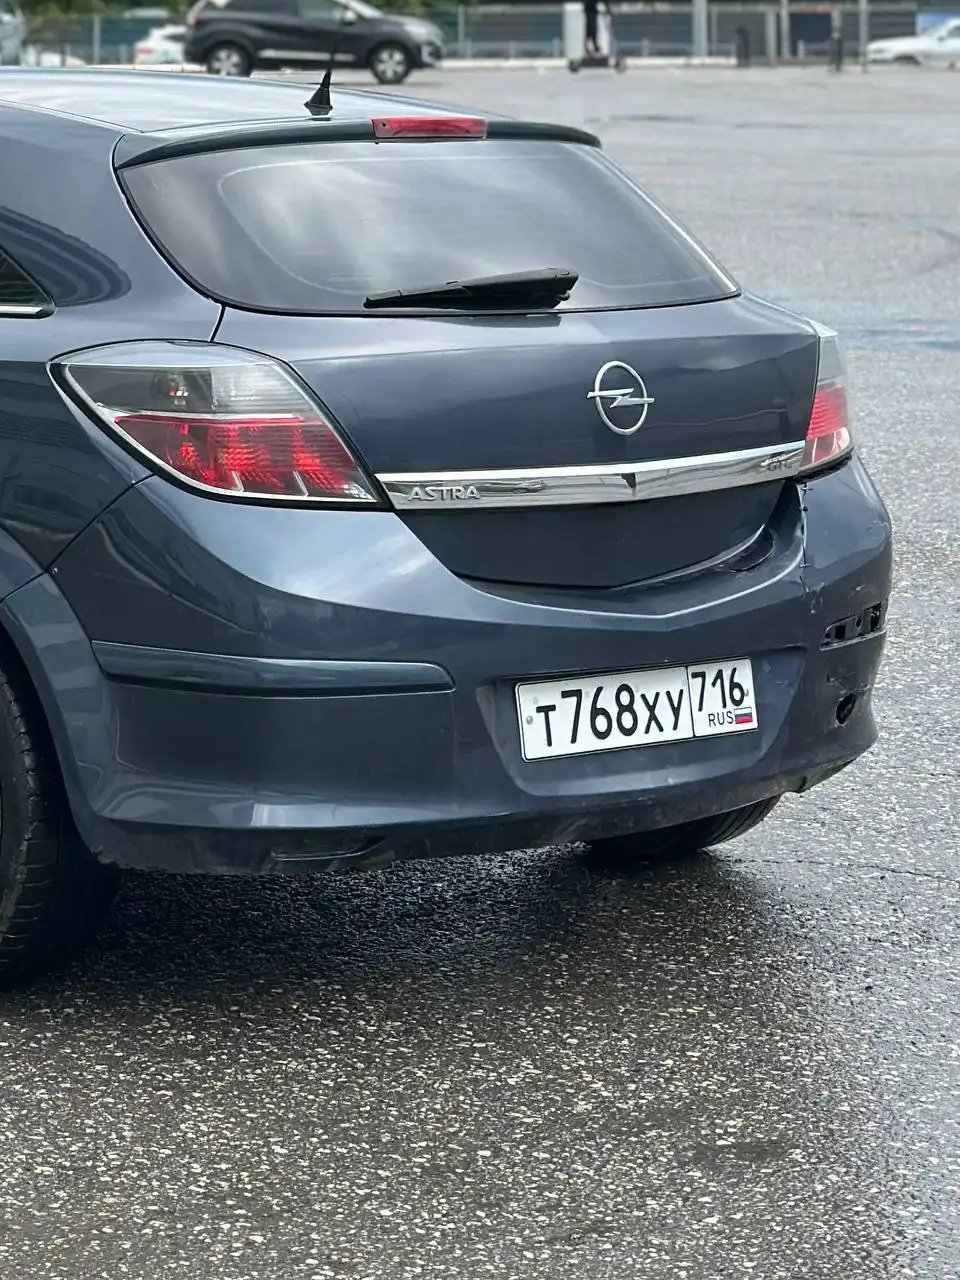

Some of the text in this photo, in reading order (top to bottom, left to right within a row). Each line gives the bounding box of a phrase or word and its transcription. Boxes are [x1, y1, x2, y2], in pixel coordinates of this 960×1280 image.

[408, 486, 480, 500] ASTRA
[691, 667, 745, 712] 716
[708, 711, 734, 727] RUS
